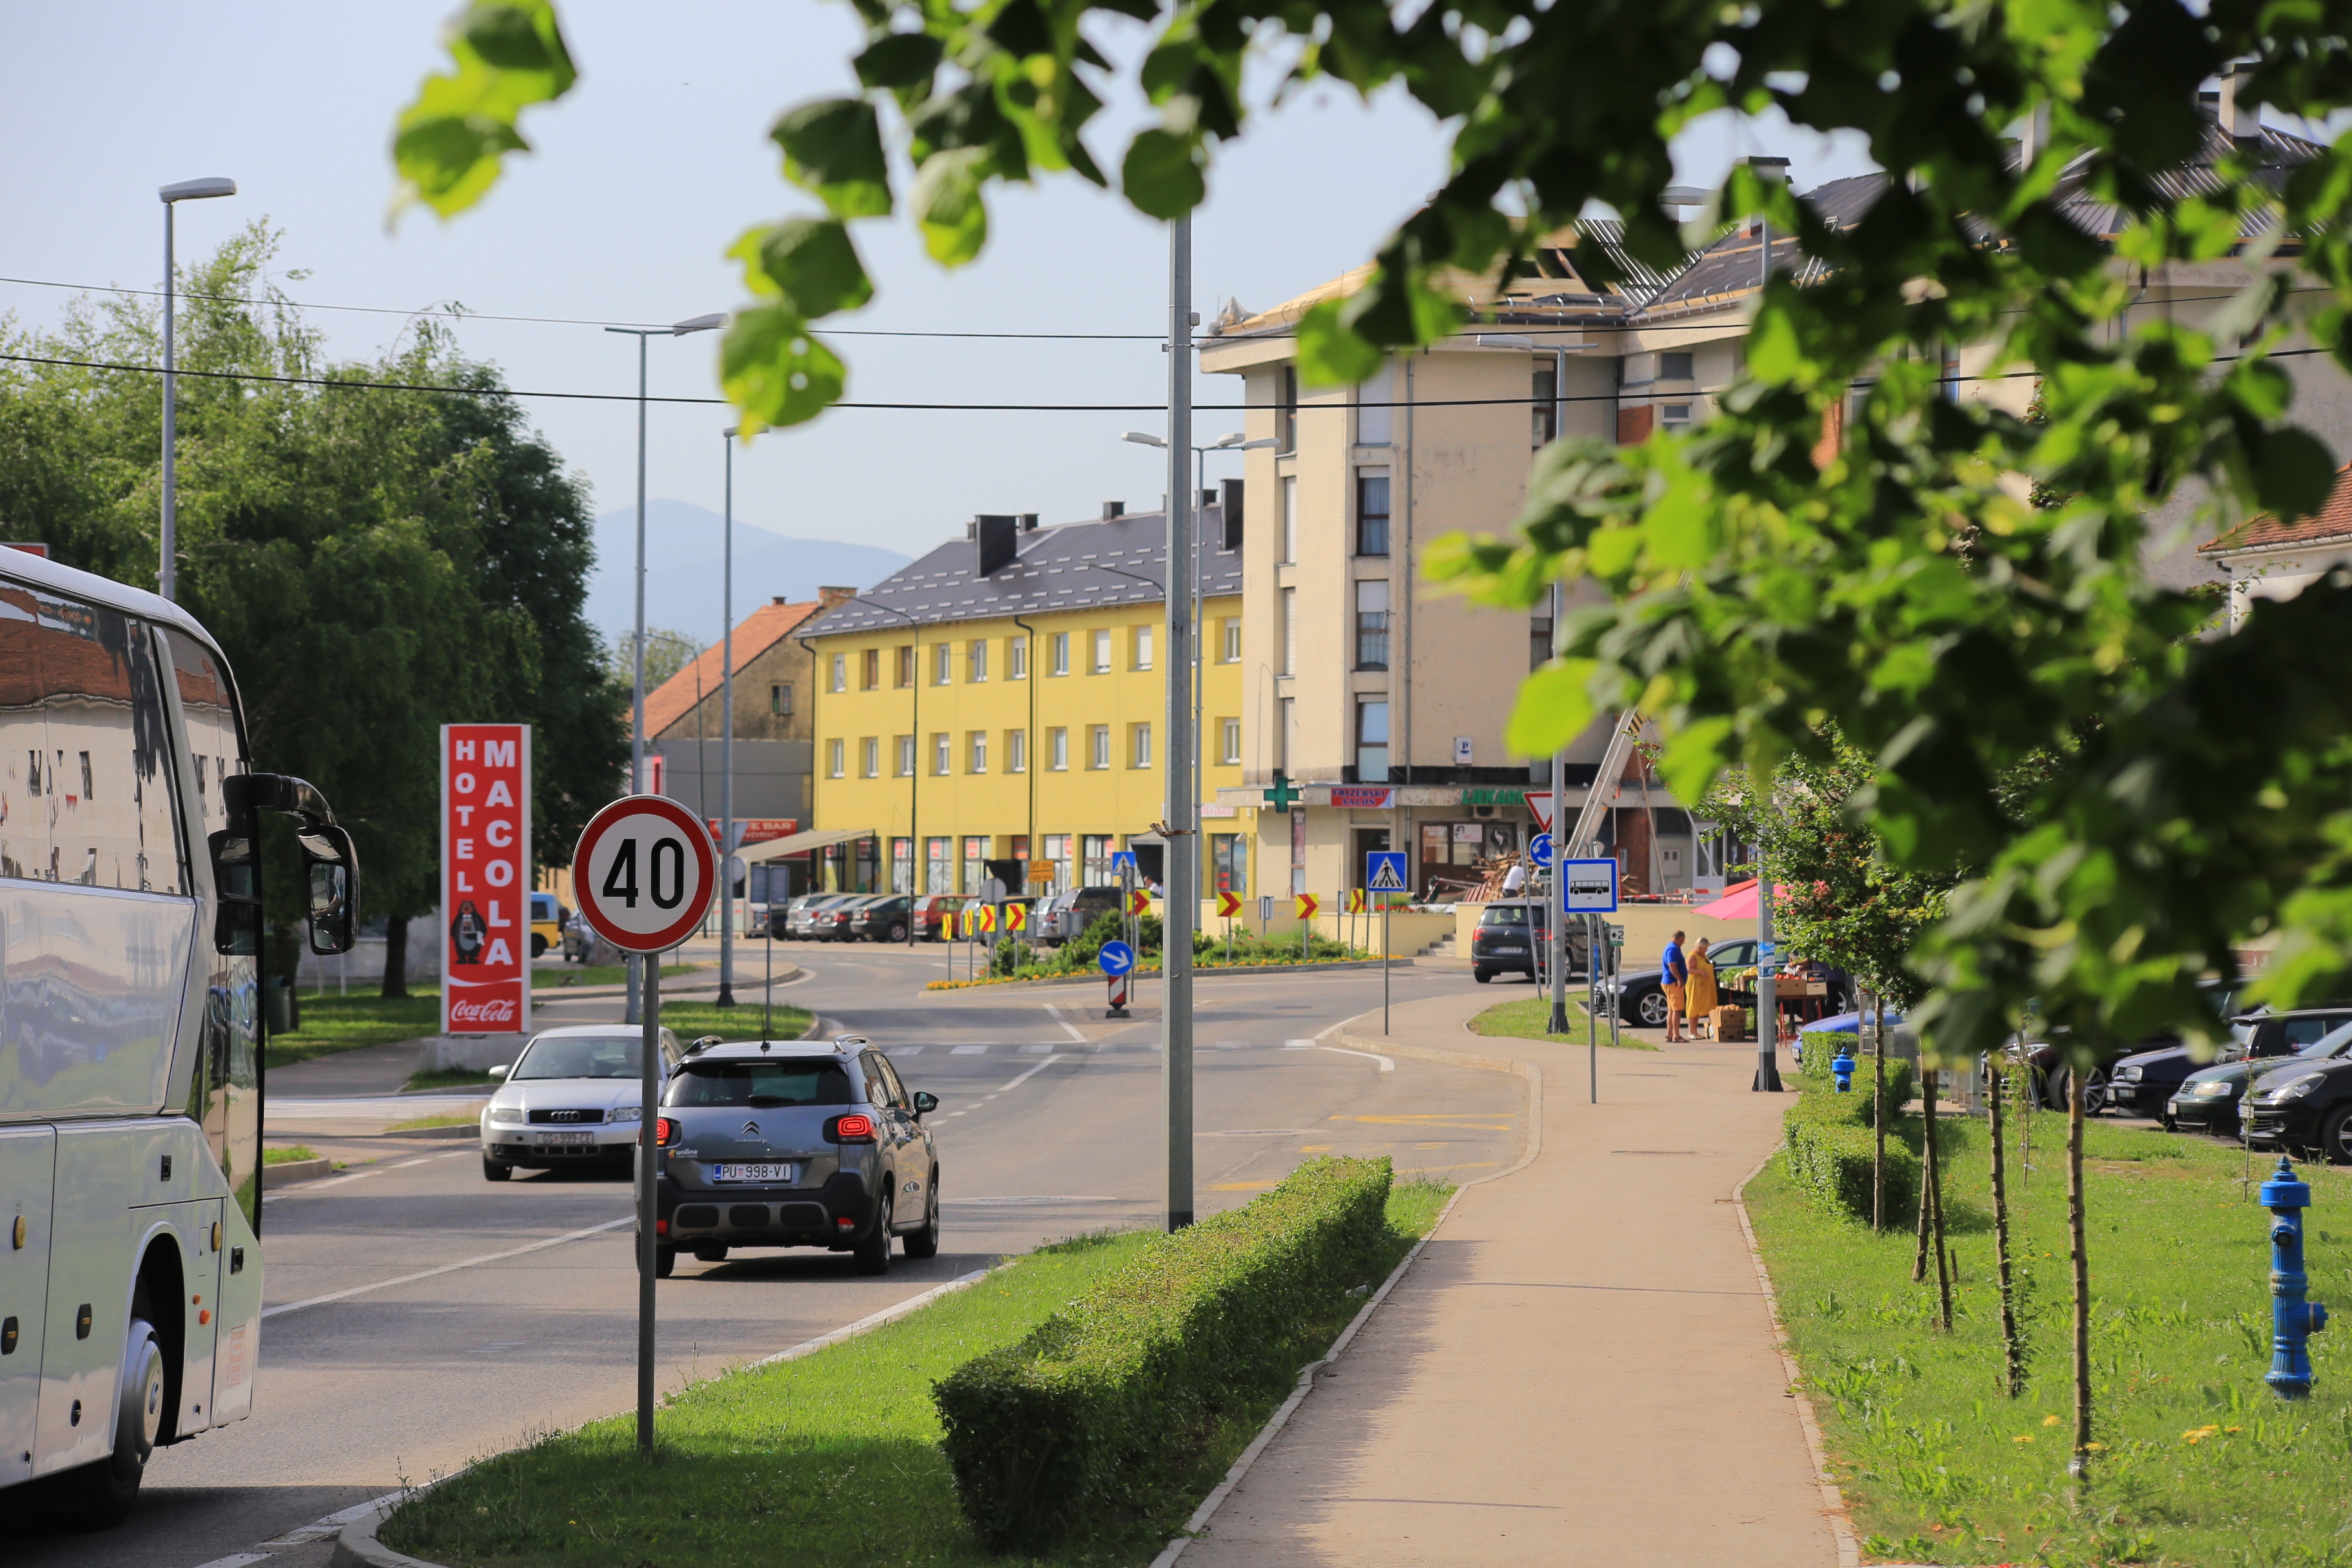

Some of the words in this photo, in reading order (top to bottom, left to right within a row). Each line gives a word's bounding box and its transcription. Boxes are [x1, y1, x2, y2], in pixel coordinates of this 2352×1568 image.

[1461, 789, 1529, 805] LJEKARN
[455, 740, 476, 892] HOTEL
[763, 822, 792, 830] BAR
[484, 740, 516, 965] MACOLA
[603, 838, 685, 910] 40
[1618, 930, 1624, 939] 2
[722, 1166, 737, 1178] PU
[745, 1166, 787, 1177] 998-VI
